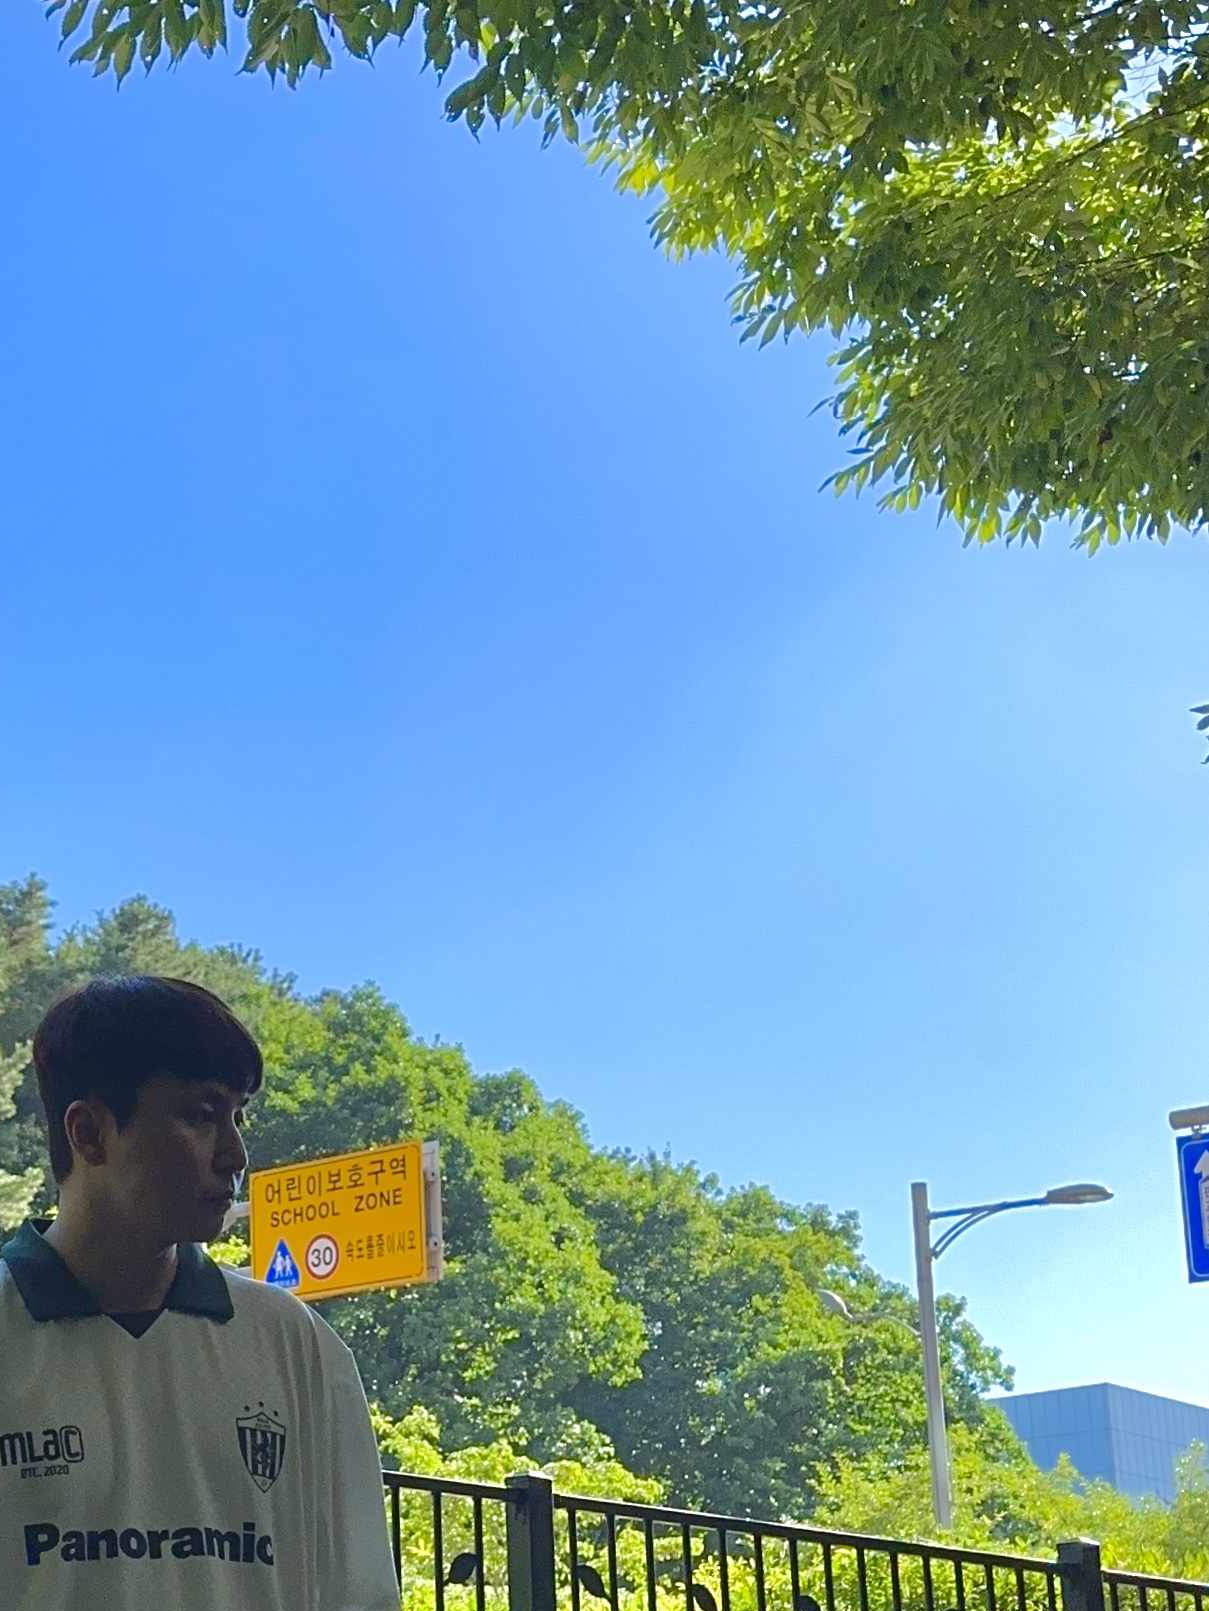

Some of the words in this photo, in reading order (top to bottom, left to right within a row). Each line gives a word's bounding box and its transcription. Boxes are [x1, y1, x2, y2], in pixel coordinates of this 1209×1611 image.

[265, 1154, 407, 1204] 어린이보호구역
[270, 1200, 340, 1228] SCHOOL
[354, 1188, 403, 1213] ZONE
[310, 1246, 334, 1268] 30
[43, 1464, 70, 1477] 2020
[23, 1521, 275, 1566] Panoramic
